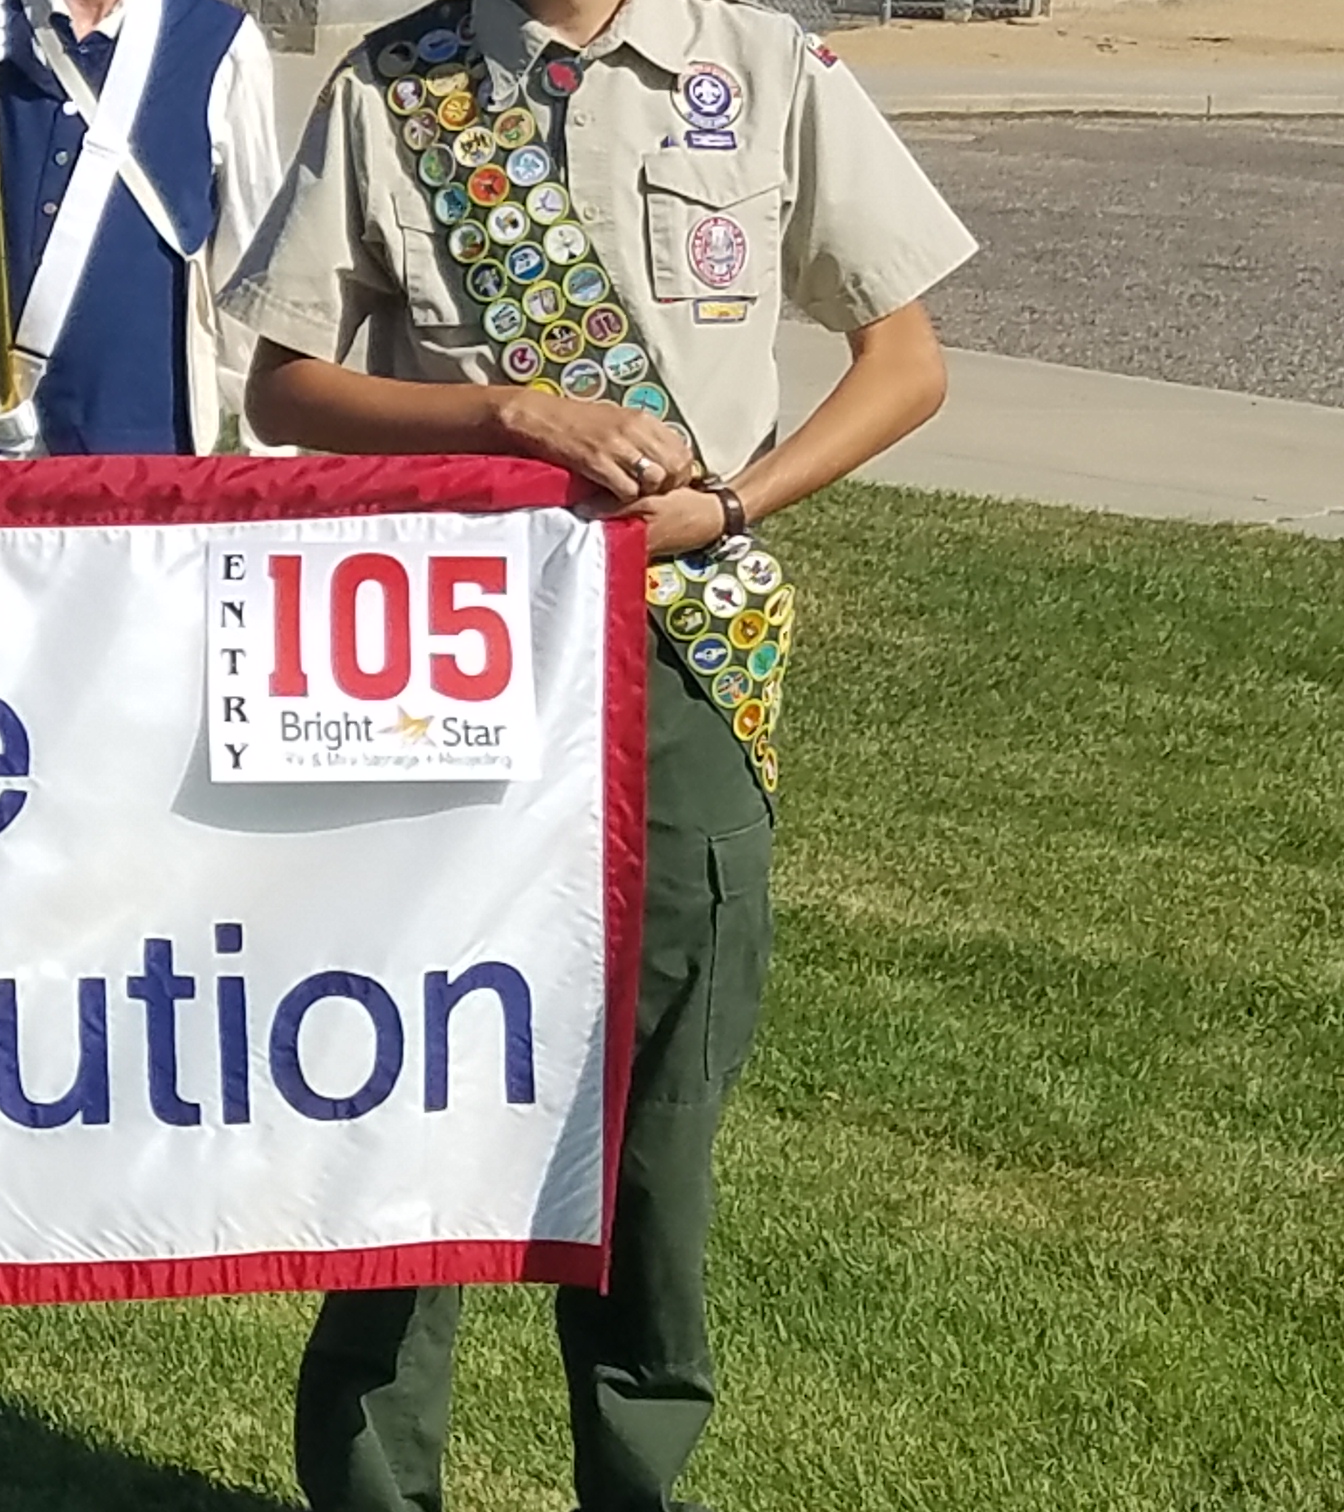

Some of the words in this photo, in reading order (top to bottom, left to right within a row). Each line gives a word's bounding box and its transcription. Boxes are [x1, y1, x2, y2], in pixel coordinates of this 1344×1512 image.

[220, 553, 250, 770] ENTRY
[268, 552, 512, 701] 105
[281, 711, 374, 751] Bright
[442, 716, 507, 747] Star
